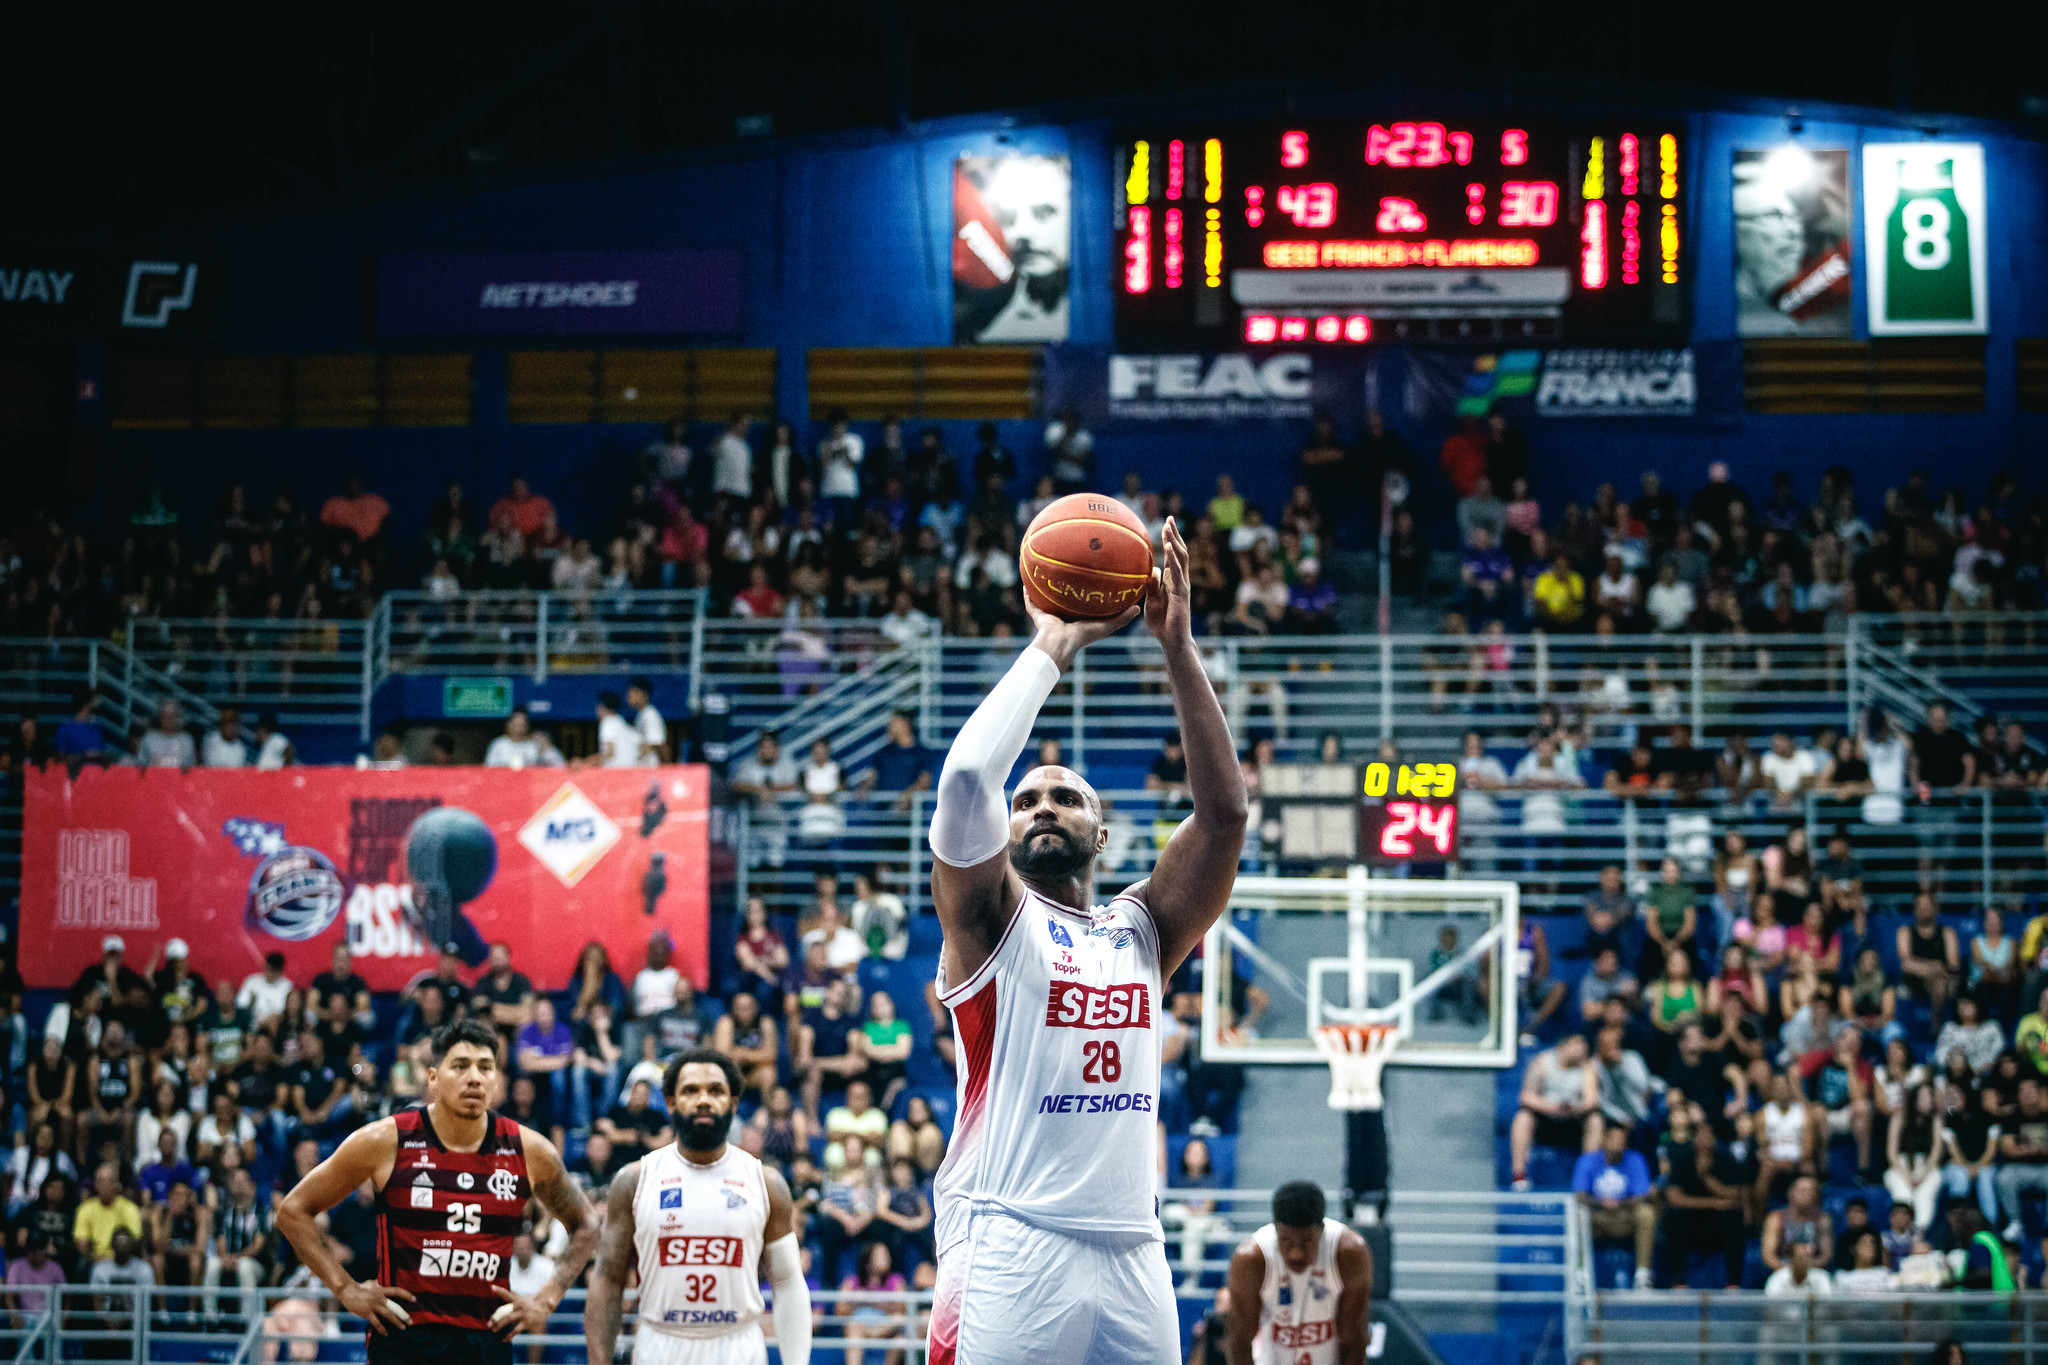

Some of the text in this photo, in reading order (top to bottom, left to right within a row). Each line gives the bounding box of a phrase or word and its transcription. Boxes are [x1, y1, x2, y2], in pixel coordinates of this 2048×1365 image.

[1282, 130, 1309, 168] 5
[1500, 129, 1528, 165] 5
[1277, 182, 1337, 228] 43
[1498, 181, 1559, 226] 30
[1902, 199, 1950, 271] 8
[480, 279, 638, 310] NETSHOES
[1108, 354, 1313, 400] FEAC
[1536, 371, 1696, 406] FRANCA
[1380, 801, 1455, 856] 24
[1057, 987, 1141, 1025] SESI
[1083, 1041, 1121, 1083] 28
[1039, 1093, 1151, 1114] NETSHOES
[446, 1202, 482, 1234] 25
[449, 1249, 500, 1282] BRB
[666, 1238, 737, 1265] SESI
[685, 1273, 717, 1303] 32
